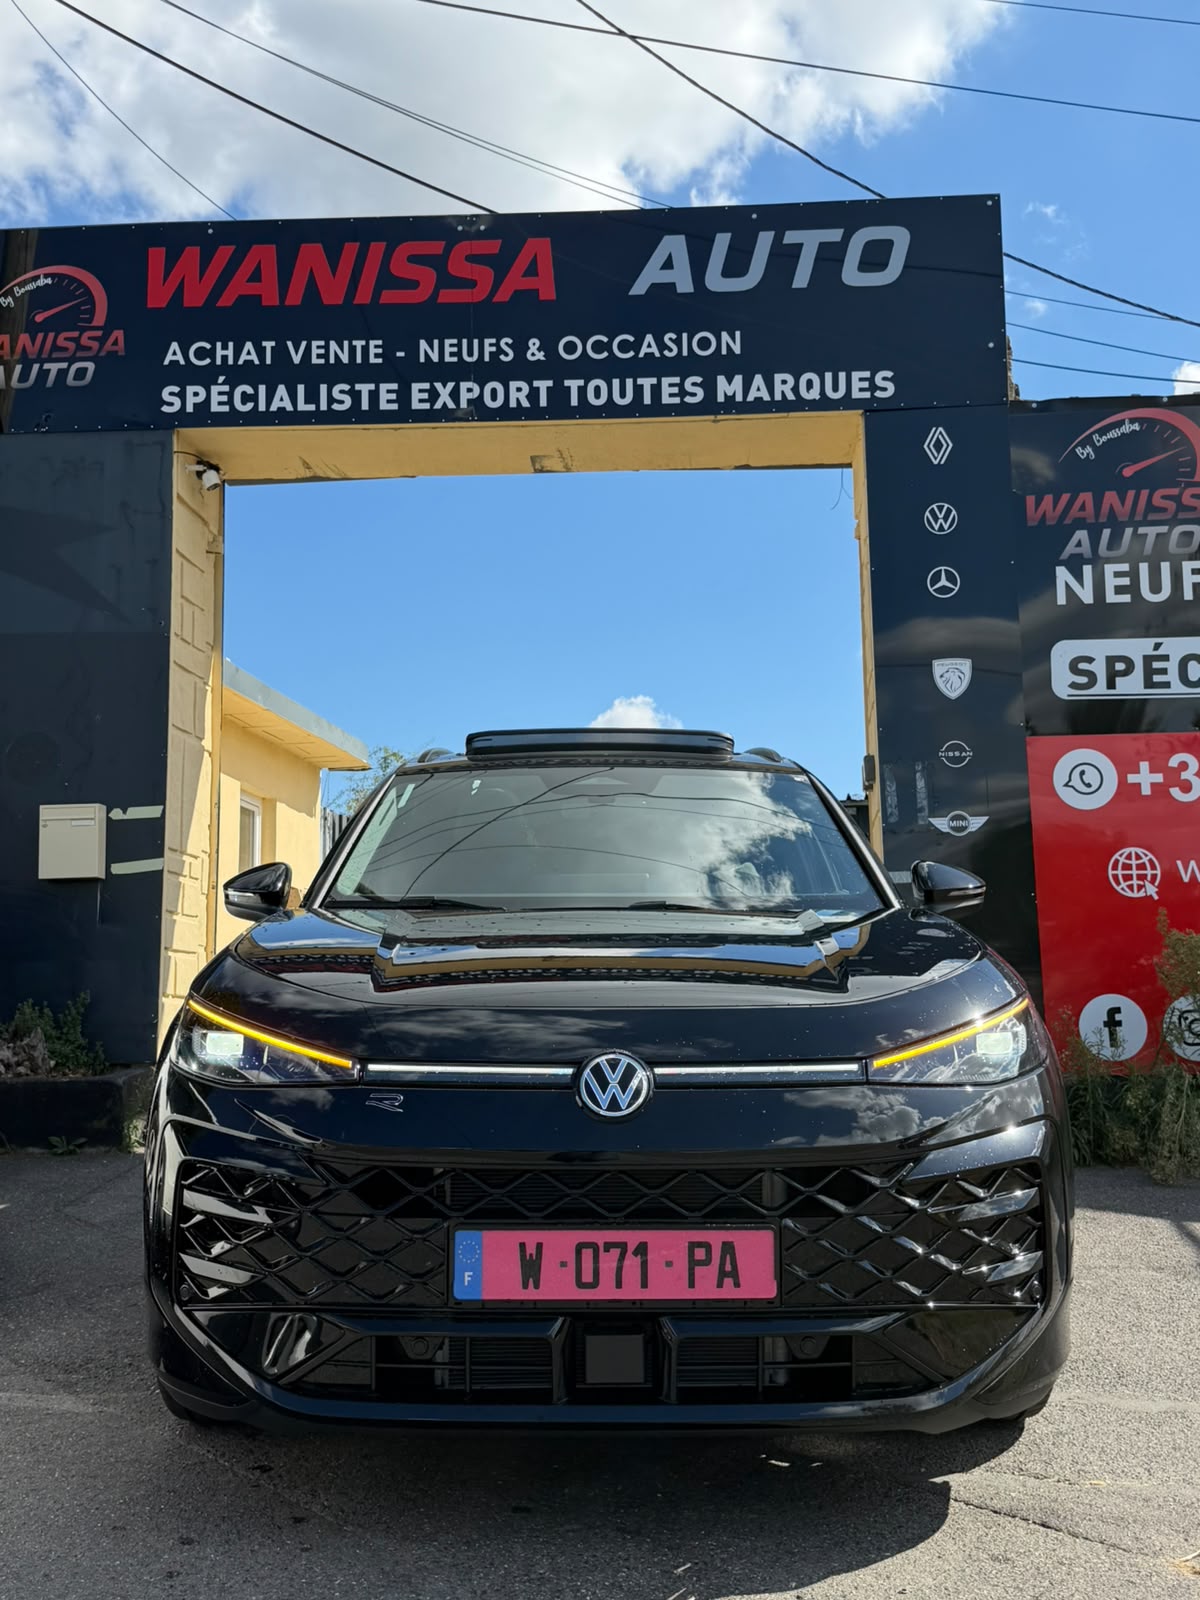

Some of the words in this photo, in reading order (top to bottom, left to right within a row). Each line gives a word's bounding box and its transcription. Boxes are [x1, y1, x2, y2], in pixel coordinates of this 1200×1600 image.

[146, 237, 557, 308] WANISSA
[628, 225, 911, 297] AUTO
[163, 340, 276, 366] ACHAT
[286, 339, 383, 365] VENTE
[419, 337, 514, 363] NEUFS
[526, 337, 546, 361] &
[557, 330, 742, 361] OCCASION
[160, 375, 399, 413] SPÉCIALISTE
[411, 379, 553, 410] EXPORT
[564, 375, 704, 407] TOUTES
[716, 370, 896, 403] MARQUES
[1075, 446, 1095, 460] By
[1092, 418, 1141, 447] Boussaba
[1059, 525, 1200, 561] AUTO
[1055, 561, 1200, 606] NEUF
[1067, 642, 1200, 691] SPÉC
[1127, 753, 1200, 803] +3
[949, 820, 969, 828] MINI
[464, 1271, 474, 1287] F
